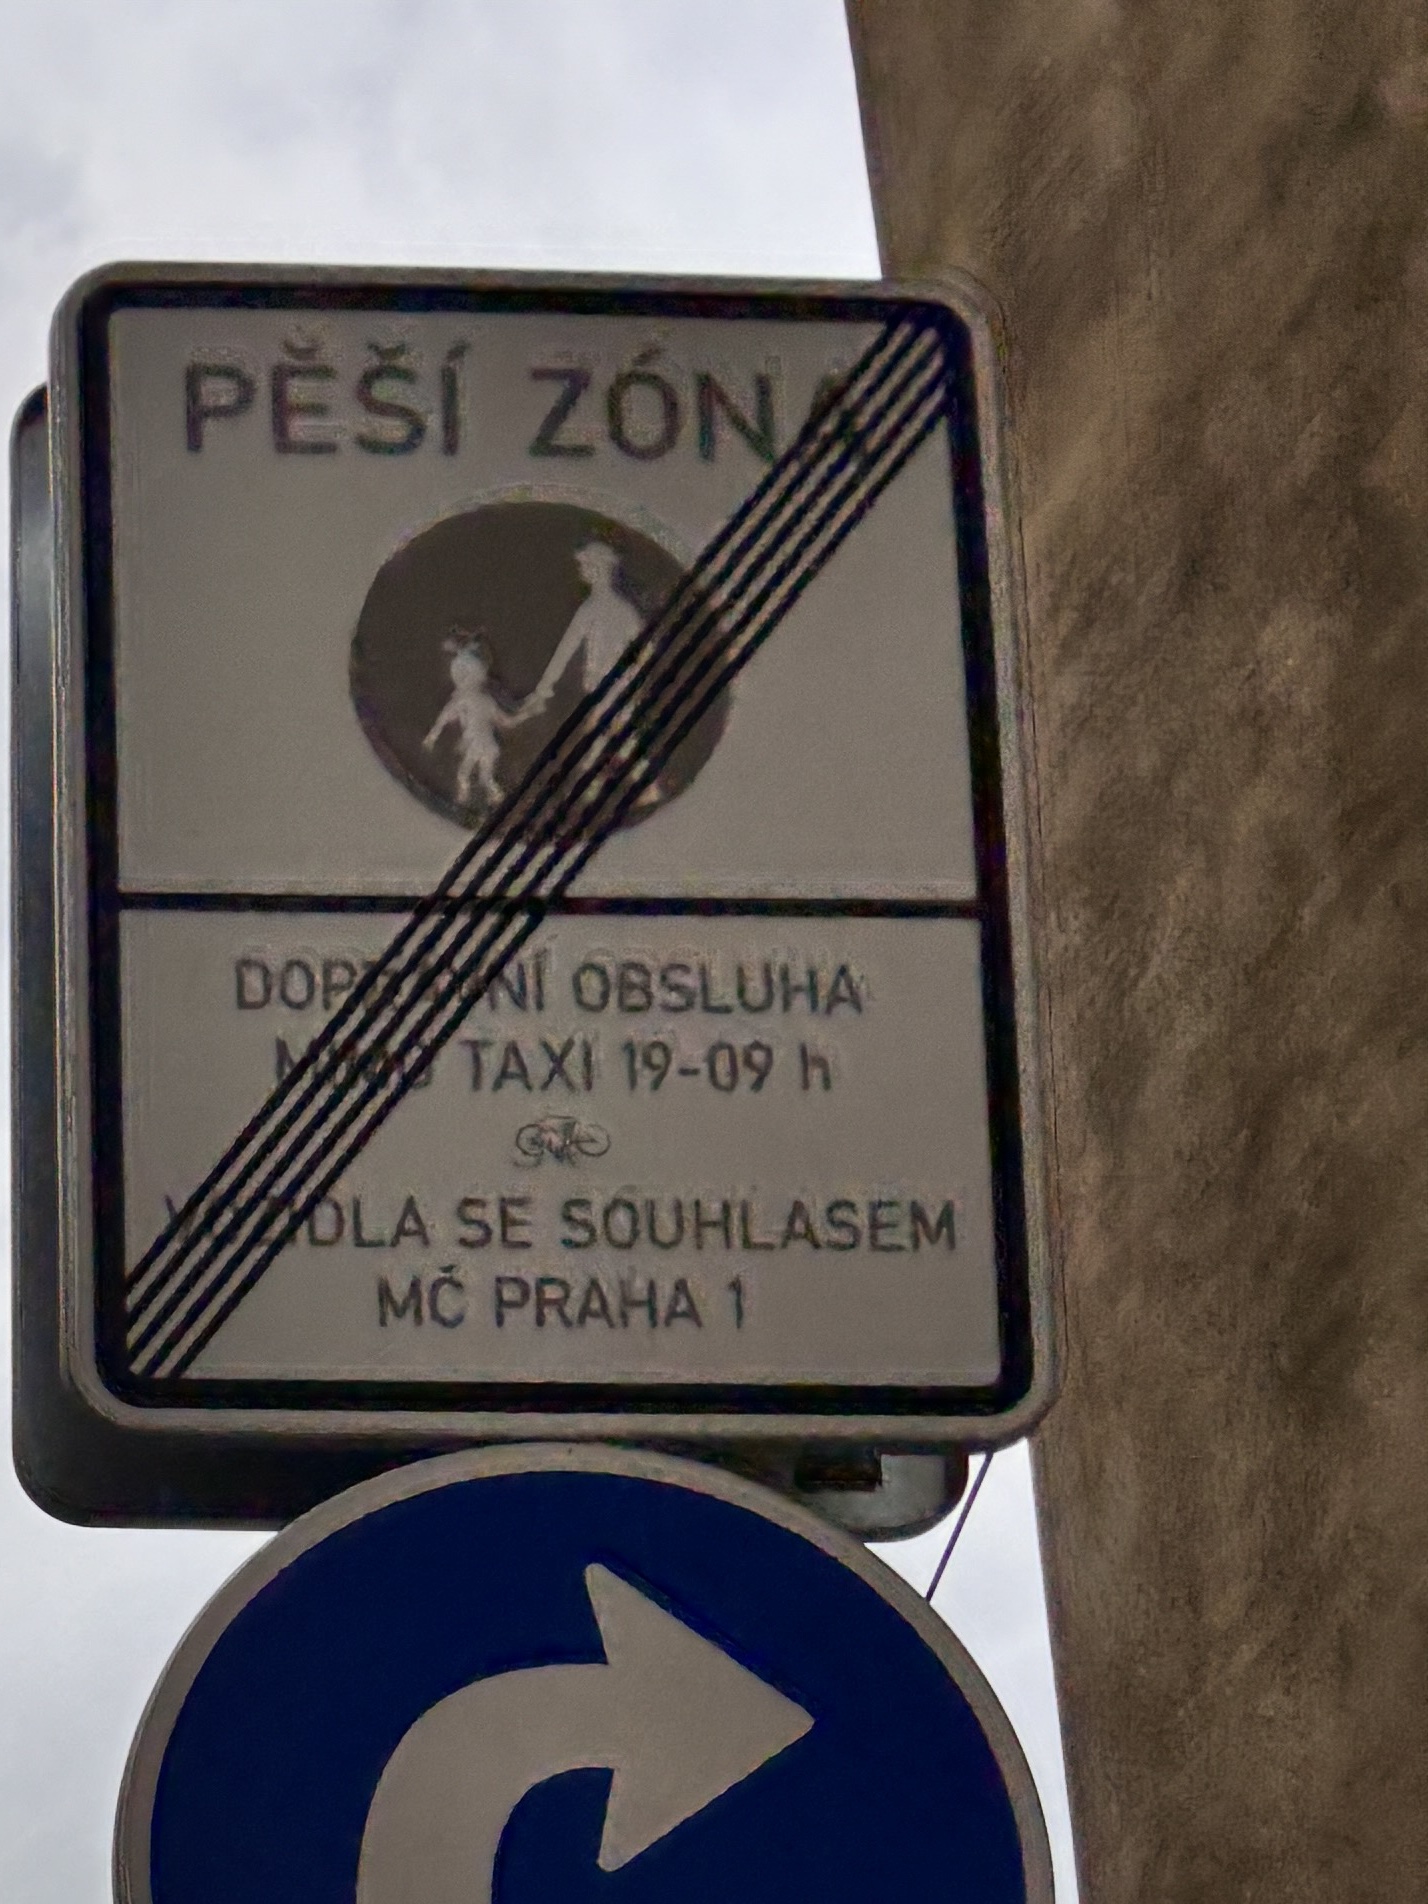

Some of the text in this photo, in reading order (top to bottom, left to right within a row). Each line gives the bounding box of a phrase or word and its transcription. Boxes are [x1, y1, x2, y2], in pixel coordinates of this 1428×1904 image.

[184, 338, 472, 456] PĚŠÍ
[572, 961, 863, 1015] OBSLUHA
[458, 1038, 594, 1092] TAXI
[622, 1040, 774, 1092] 19-09
[800, 1041, 831, 1092] h
[456, 1196, 532, 1250] SE
[561, 1196, 956, 1252] SOUHLASEM
[376, 1264, 745, 1330] MČ PRAHA 1
